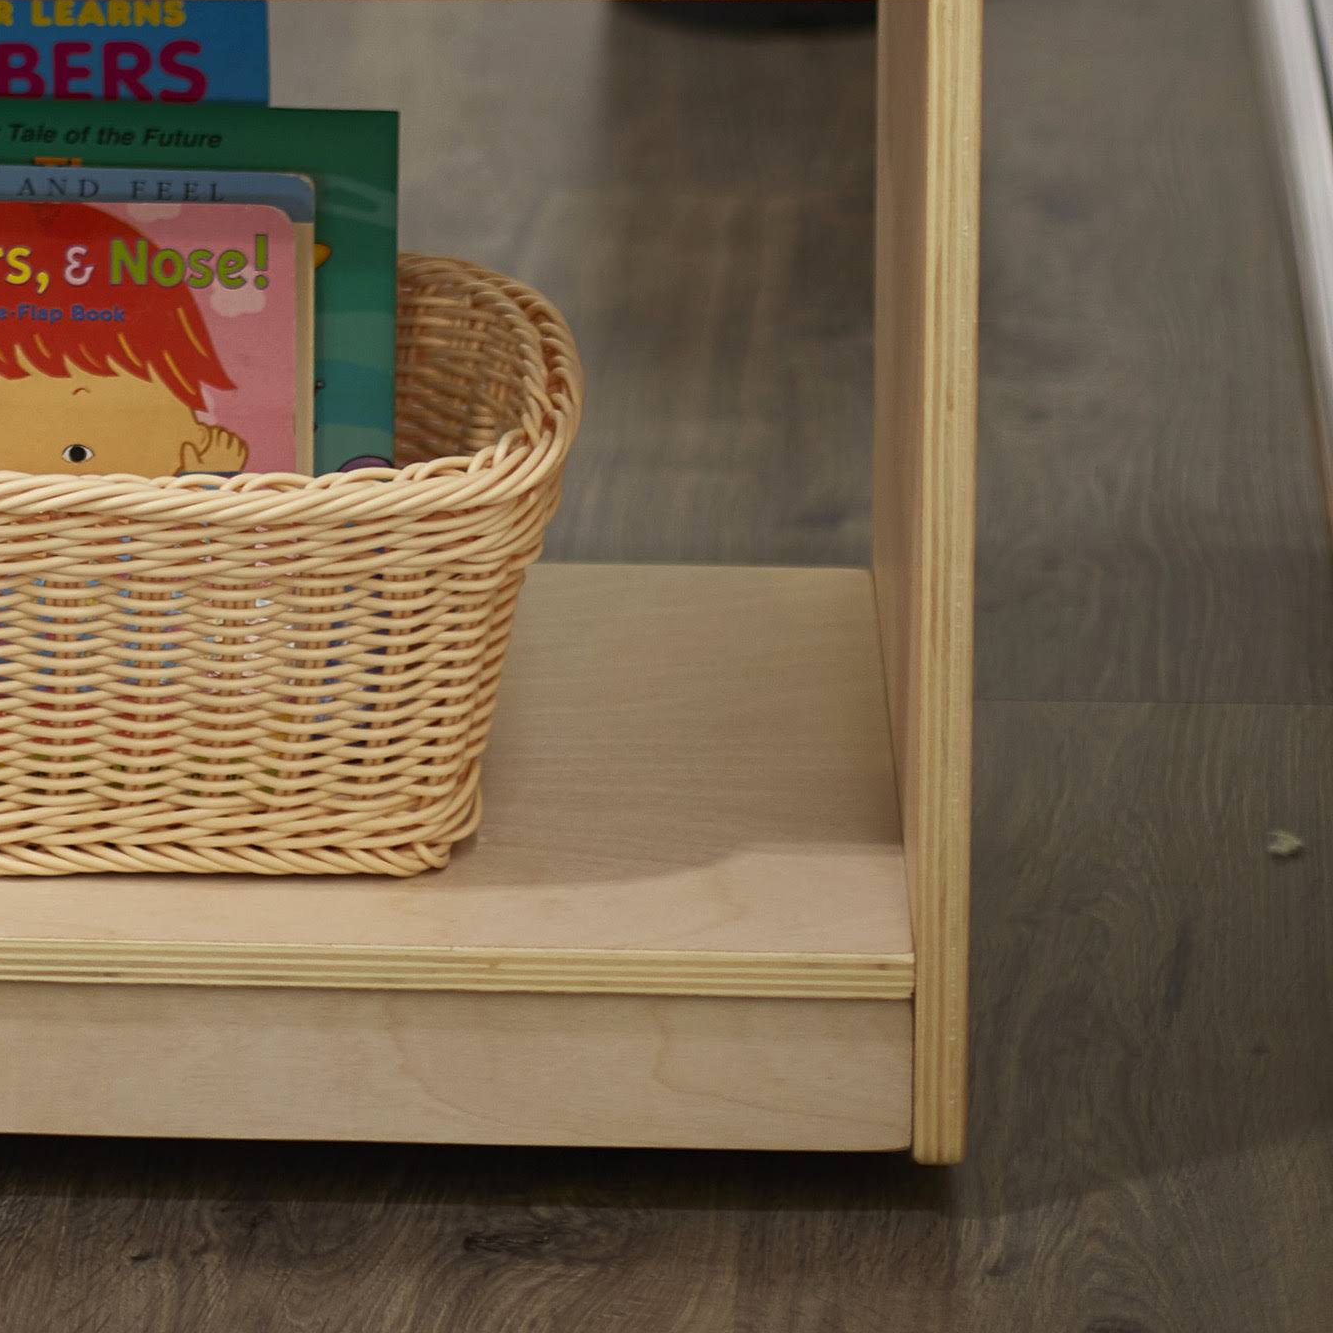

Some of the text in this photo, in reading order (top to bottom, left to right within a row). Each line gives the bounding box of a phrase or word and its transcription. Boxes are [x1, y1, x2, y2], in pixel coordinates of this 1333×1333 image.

[10, 123, 57, 144] Tale
[64, 125, 90, 145] of
[96, 126, 135, 146] the
[143, 128, 223, 149] Future
[17, 177, 101, 199] AND
[131, 180, 225, 203] FEEL
[63, 247, 94, 286] &
[109, 234, 270, 290] Nose!
[71, 303, 126, 322] Book
